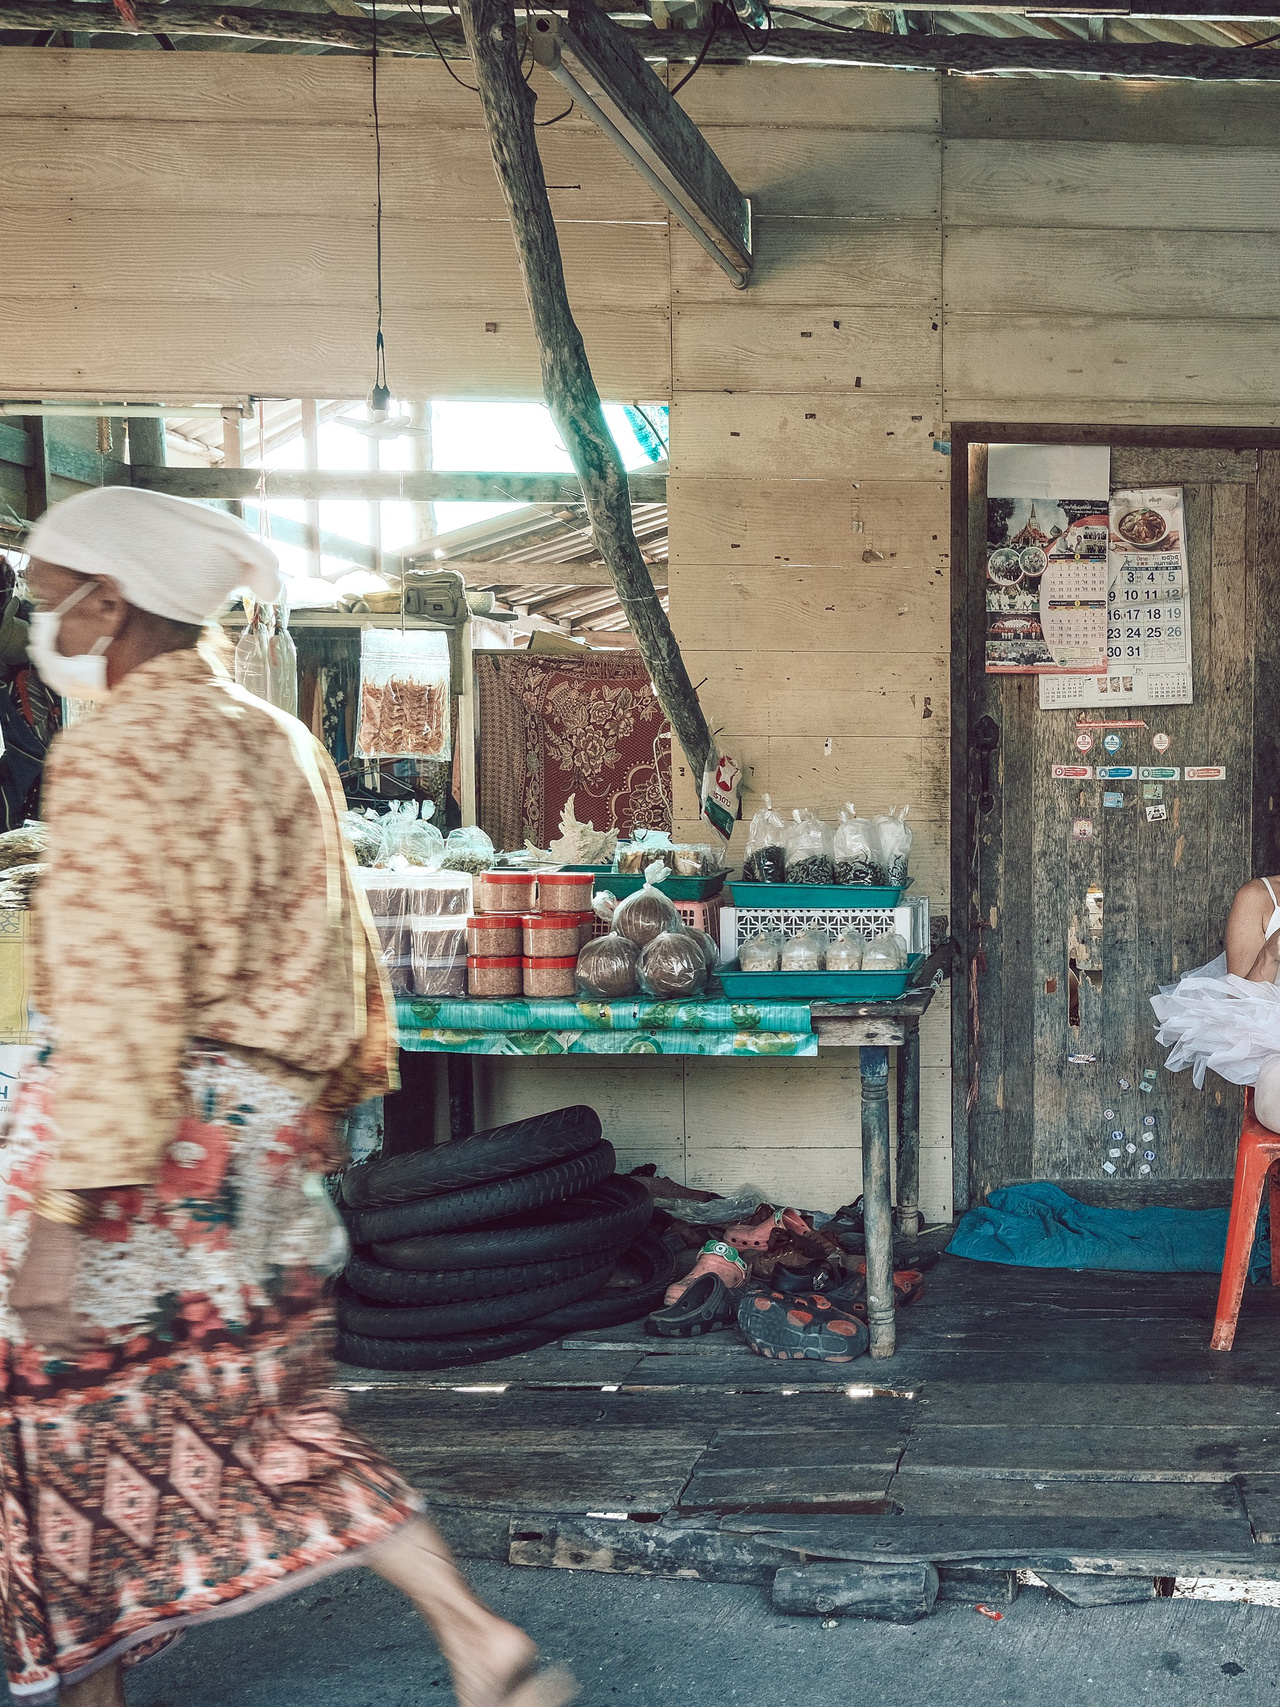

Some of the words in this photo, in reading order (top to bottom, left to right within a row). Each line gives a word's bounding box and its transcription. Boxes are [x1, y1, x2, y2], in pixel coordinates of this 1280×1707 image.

[1127, 571, 1135, 583] 3
[1147, 571, 1155, 582] 4
[1168, 571, 1175, 581] 5
[1109, 592, 1116, 602] 9
[1124, 589, 1138, 600] 10
[1145, 589, 1157, 600] 11
[1165, 589, 1179, 598] 12
[1107, 609, 1121, 621] 16
[1126, 609, 1140, 620] 17
[1146, 608, 1161, 619] 18
[1167, 607, 1181, 619] 19
[1107, 628, 1121, 639] 23
[1126, 627, 1141, 638] 24
[1146, 627, 1162, 638] 25
[1167, 626, 1182, 637] 26
[1107, 646, 1122, 657] 30
[1127, 646, 1140, 657] 31
